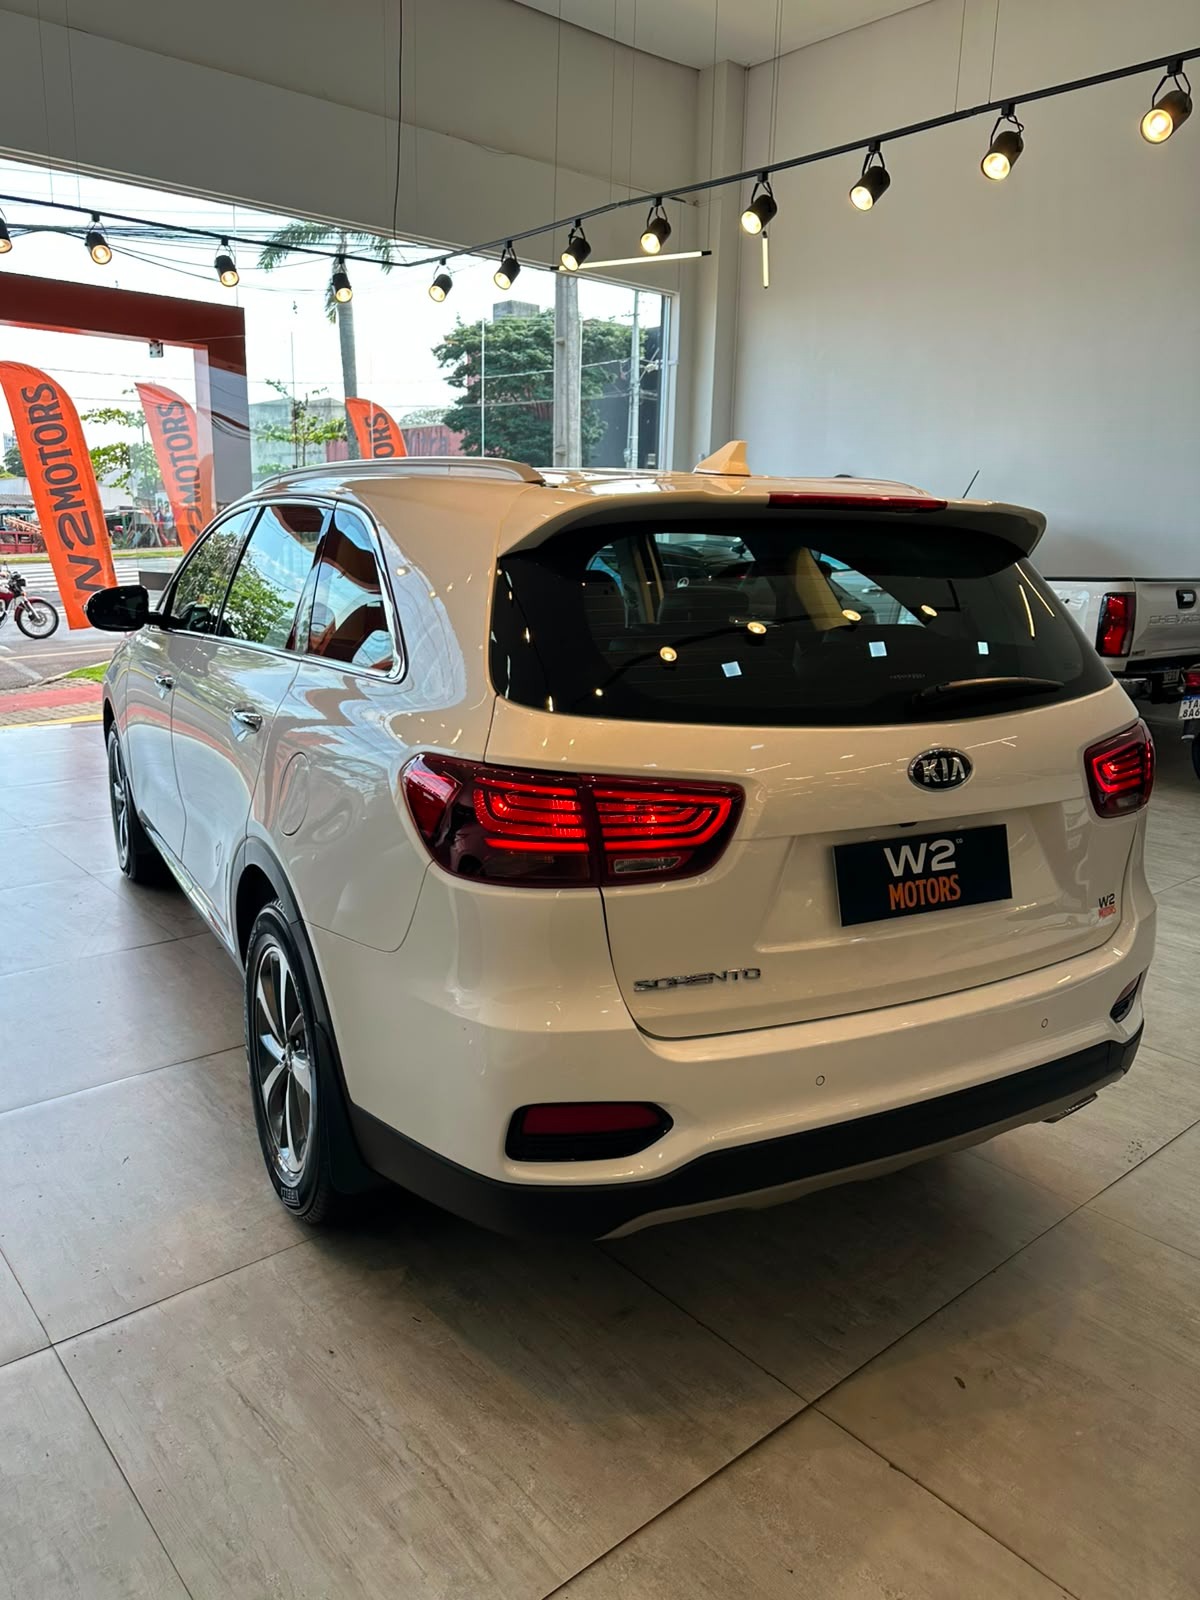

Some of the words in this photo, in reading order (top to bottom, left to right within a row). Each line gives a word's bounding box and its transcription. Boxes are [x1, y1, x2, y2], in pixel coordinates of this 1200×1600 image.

[364, 412, 395, 458] ORS
[1149, 613, 1200, 626] CHEVRO
[1183, 708, 1200, 718] 8A6
[1188, 699, 1200, 709] TA
[919, 757, 966, 783] KIA
[883, 838, 956, 877] W2
[888, 873, 961, 911] MOTORS
[1098, 893, 1115, 908] W2
